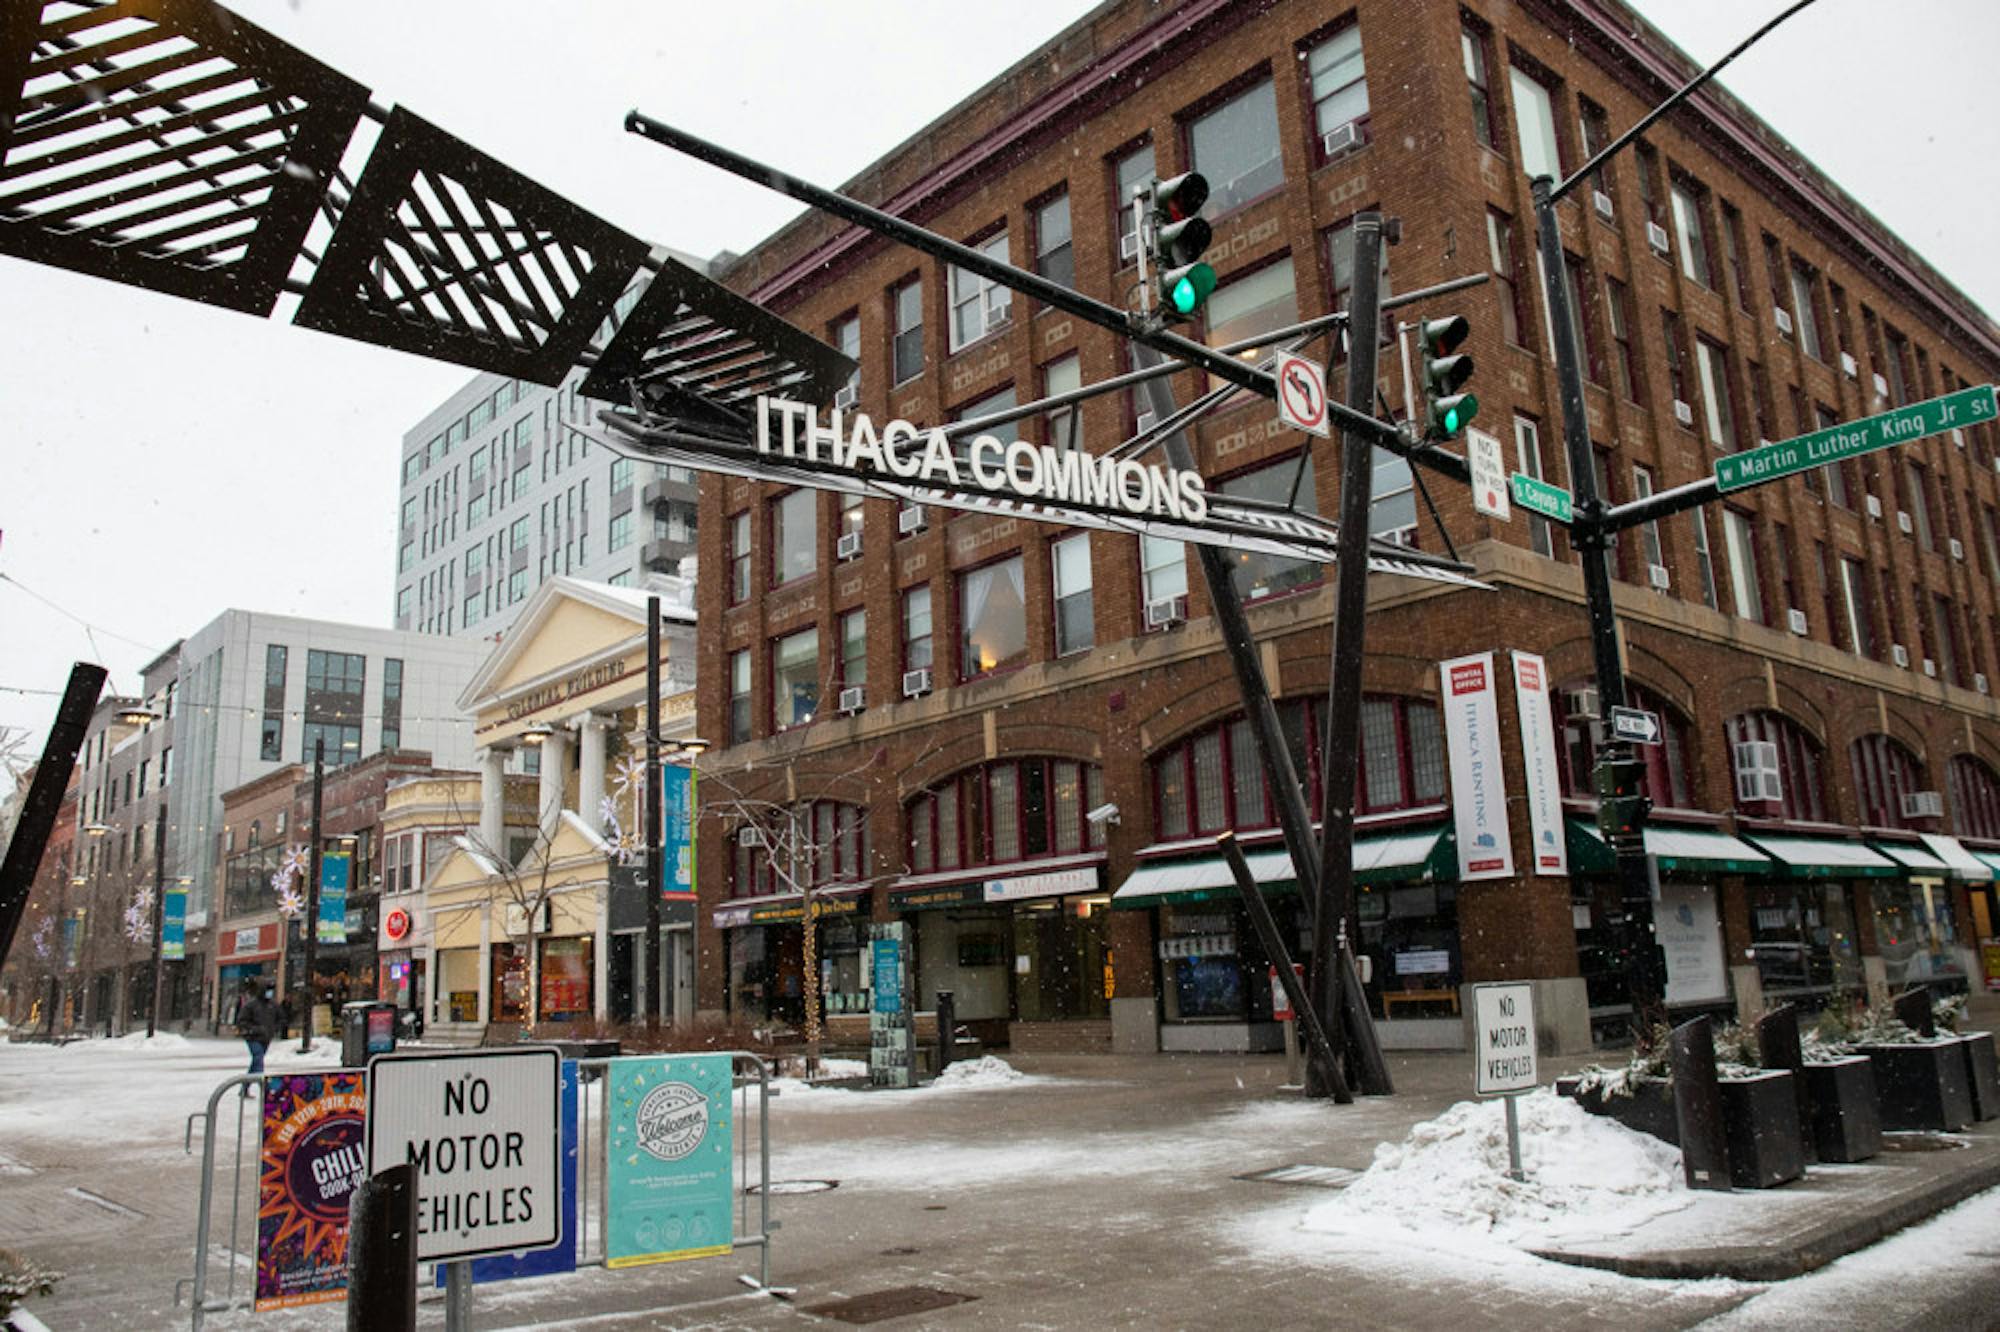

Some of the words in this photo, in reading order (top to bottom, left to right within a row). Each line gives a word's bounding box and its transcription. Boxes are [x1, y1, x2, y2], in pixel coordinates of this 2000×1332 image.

[1477, 438, 1493, 457] NO
[1740, 448, 1797, 480] Martin
[1808, 428, 1869, 460] Luther
[1881, 413, 1926, 439] King
[1938, 400, 1957, 426] Jr
[756, 395, 961, 485] ITHACA
[970, 434, 1208, 522] COMMONS
[1477, 455, 1498, 474] TURN
[1475, 470, 1487, 485] ON
[567, 659, 626, 693] BUILDING
[1454, 668, 1483, 681] RENTAL
[1455, 677, 1484, 690] OFFICE
[1465, 702, 1480, 757] ITHACA
[1472, 761, 1488, 828] RENTING
[1499, 997, 1515, 1017] NO
[1489, 1026, 1528, 1049] MOTOR
[1487, 1055, 1532, 1080] VEHICLES
[444, 1078, 490, 1116] NO
[406, 1131, 525, 1176] MOTOR
[417, 1186, 533, 1234] EHICLES
